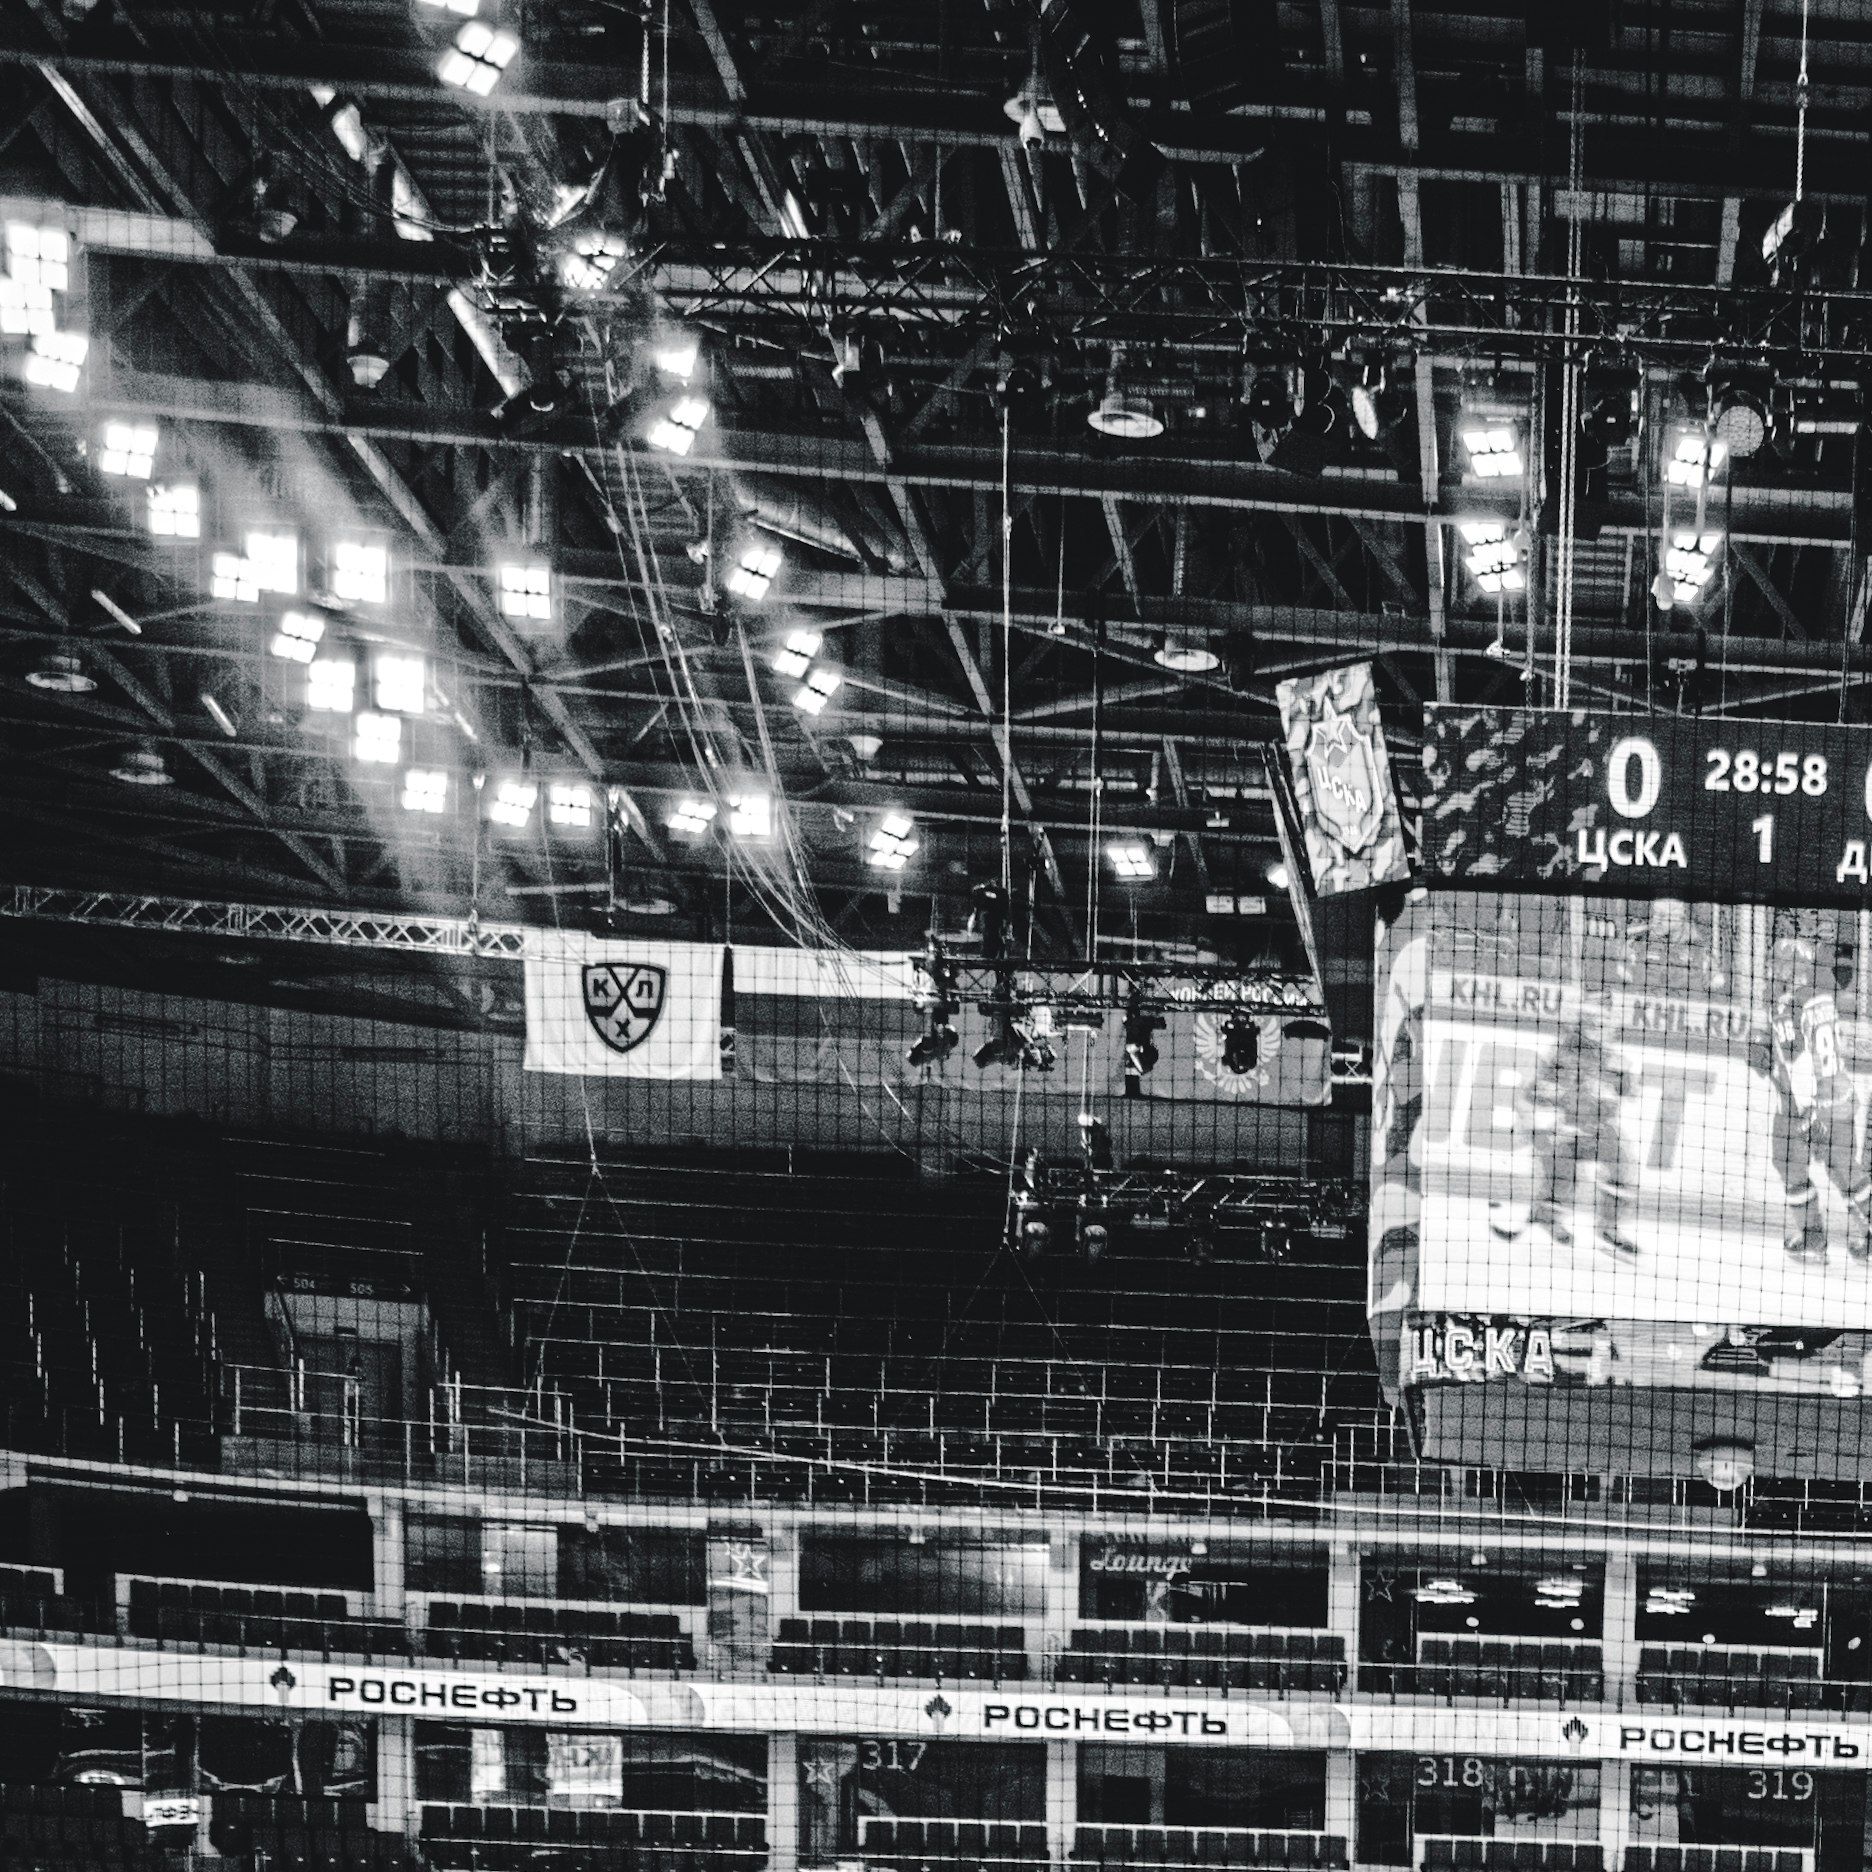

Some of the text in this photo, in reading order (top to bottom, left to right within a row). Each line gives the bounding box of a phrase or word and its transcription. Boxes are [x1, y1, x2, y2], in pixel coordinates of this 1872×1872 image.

[1317, 766, 1367, 814] ЦСКА
[1608, 737, 1661, 818] 0
[1704, 748, 1828, 796] 28:58
[1578, 828, 1687, 872] ЦСКА
[1752, 814, 1774, 864] 1
[1453, 978, 1562, 1016] KHL.RU
[1633, 1001, 1747, 1036] KHL.RU
[1412, 1327, 1552, 1378] ЦСКА
[1090, 1547, 1191, 1581] Lounge
[330, 1677, 577, 1713] РОСНЕФТЬ
[984, 1704, 1227, 1735] РОСНЕФТЬ
[862, 1741, 927, 1770] 317
[1620, 1725, 1859, 1759] РОСНЕФТЬ
[1417, 1757, 1483, 1787] 318
[1747, 1770, 1814, 1801] 319
